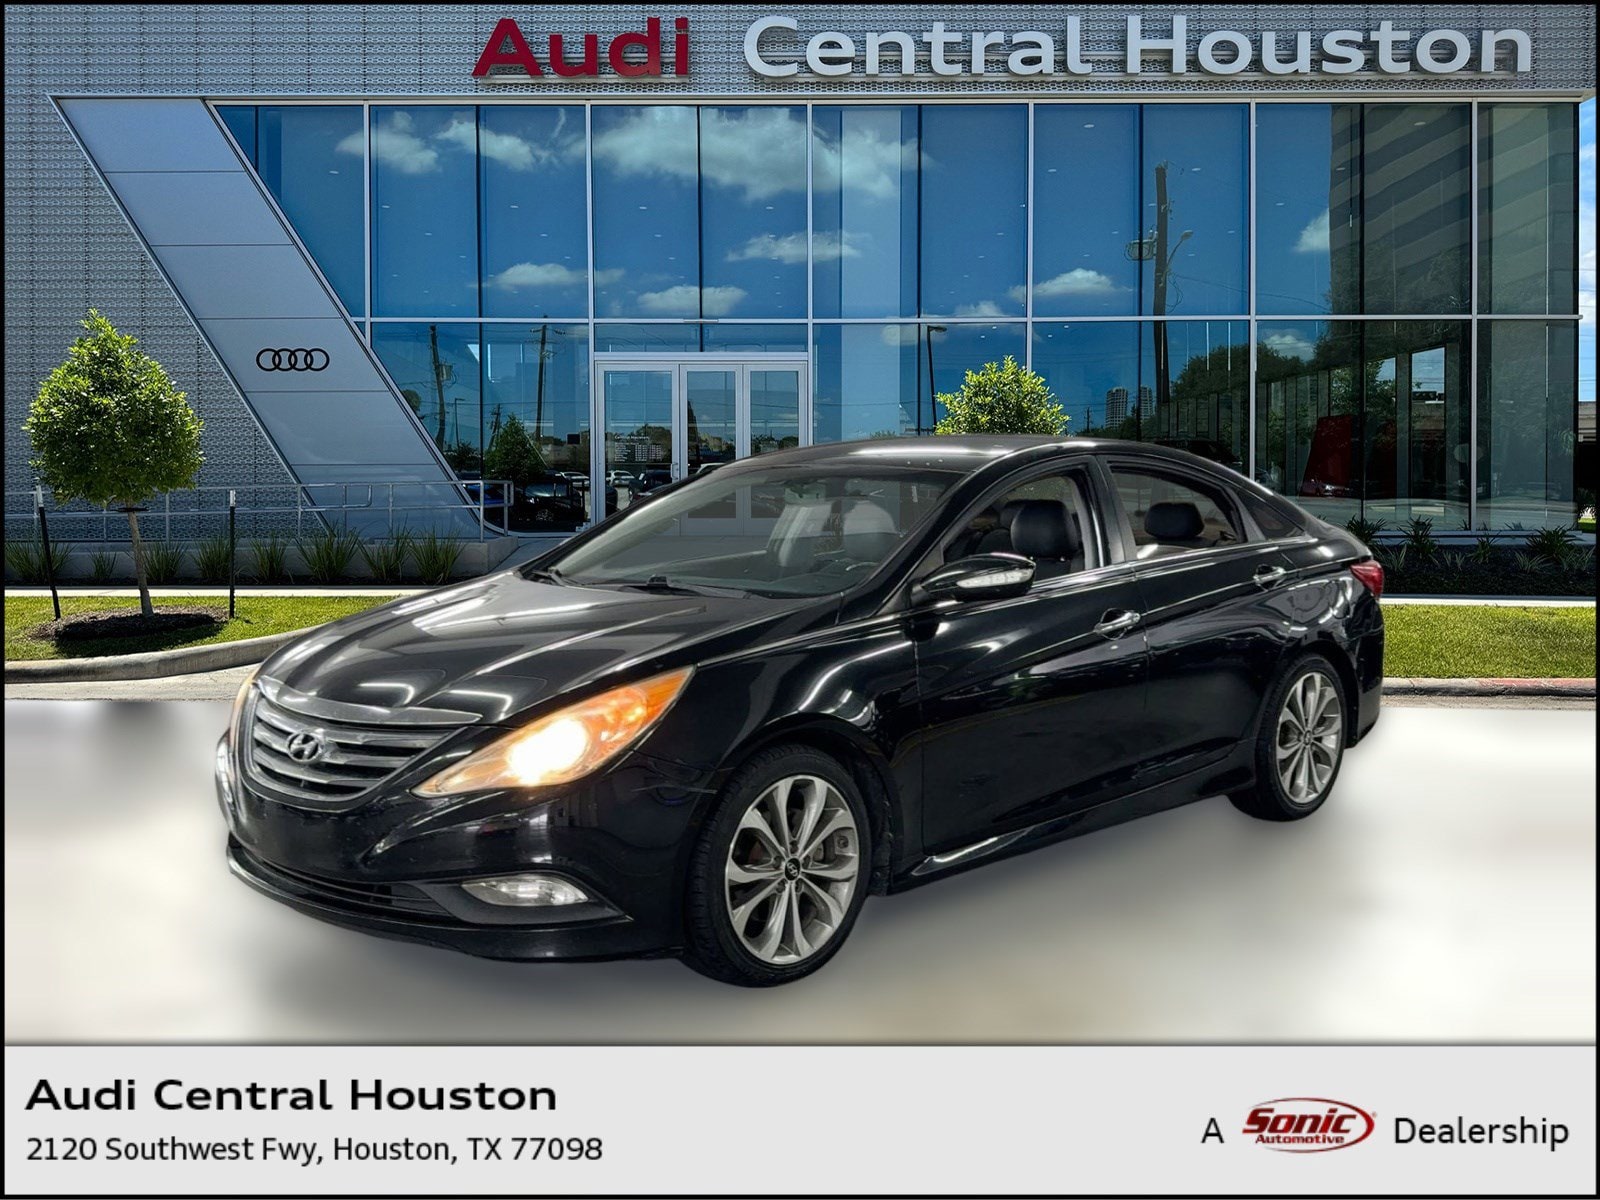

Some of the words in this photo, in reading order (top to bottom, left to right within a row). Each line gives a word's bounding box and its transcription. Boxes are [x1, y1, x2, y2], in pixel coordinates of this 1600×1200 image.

[472, 17, 690, 77] Audi
[743, 15, 1093, 77] Central
[1126, 14, 1532, 76] Houston
